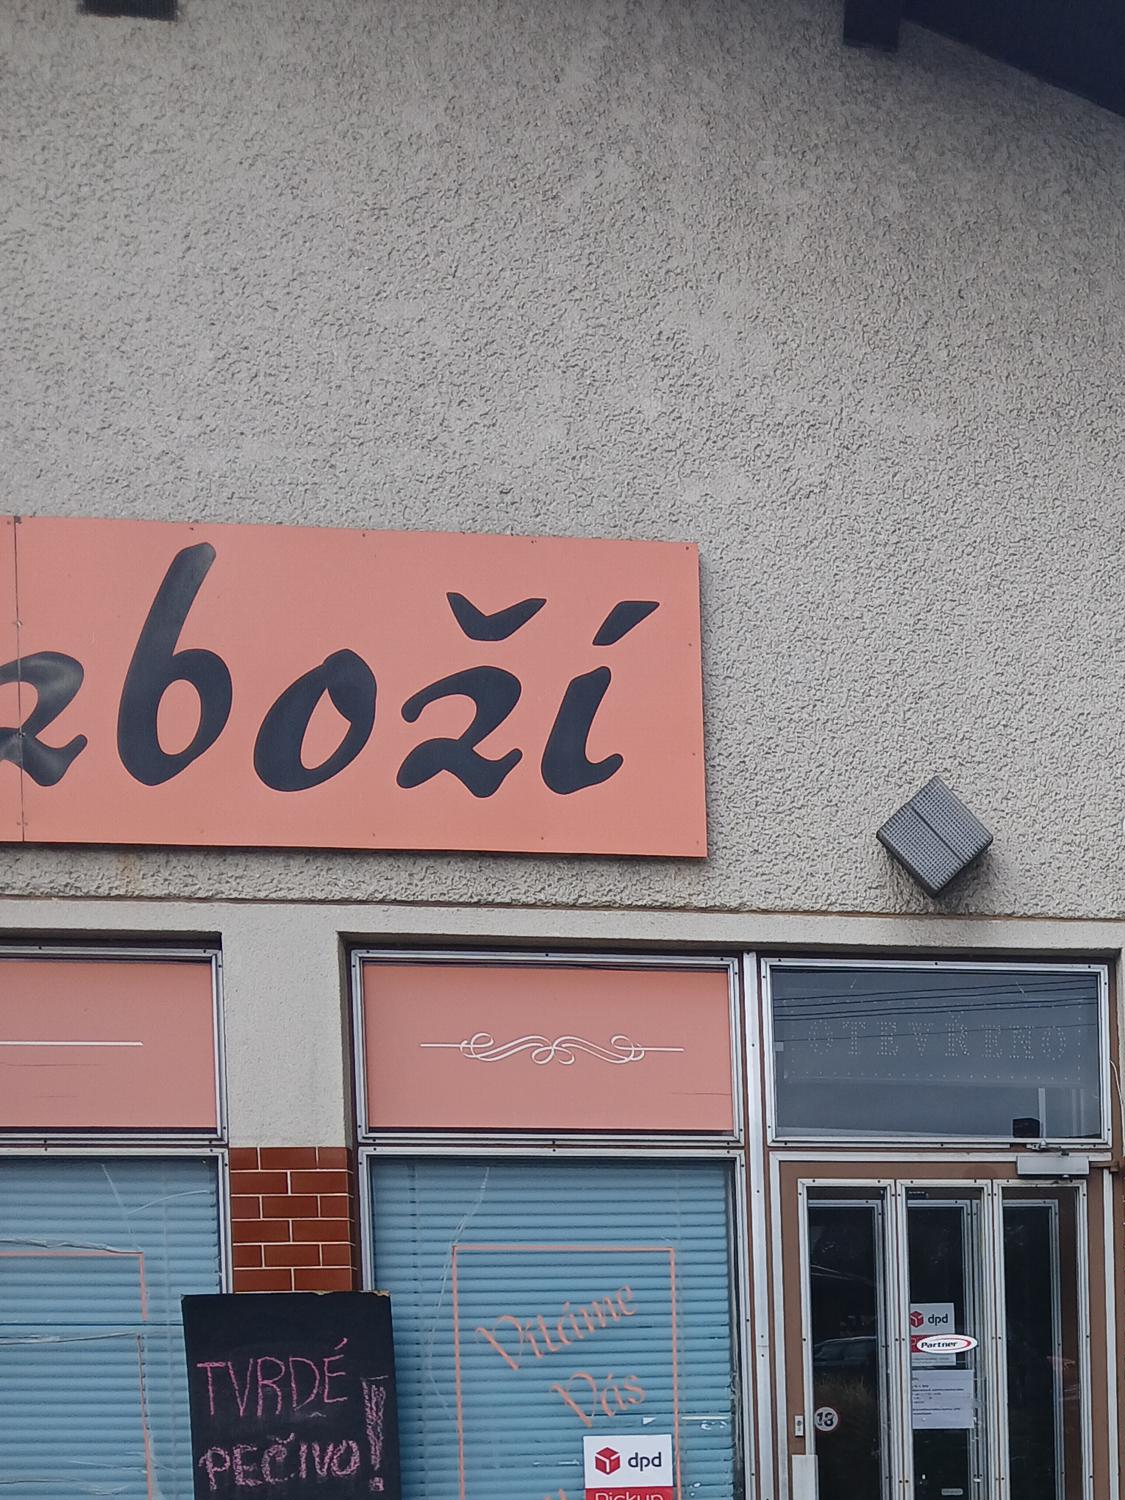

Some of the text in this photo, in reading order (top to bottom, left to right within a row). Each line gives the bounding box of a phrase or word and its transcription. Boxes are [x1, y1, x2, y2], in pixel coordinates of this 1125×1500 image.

[927, 1313, 949, 1326] dpd
[921, 1341, 958, 1349] Partner
[197, 1338, 348, 1416] TVRDÉ
[551, 1372, 646, 1429] Vás
[628, 1452, 662, 1471] dpd
